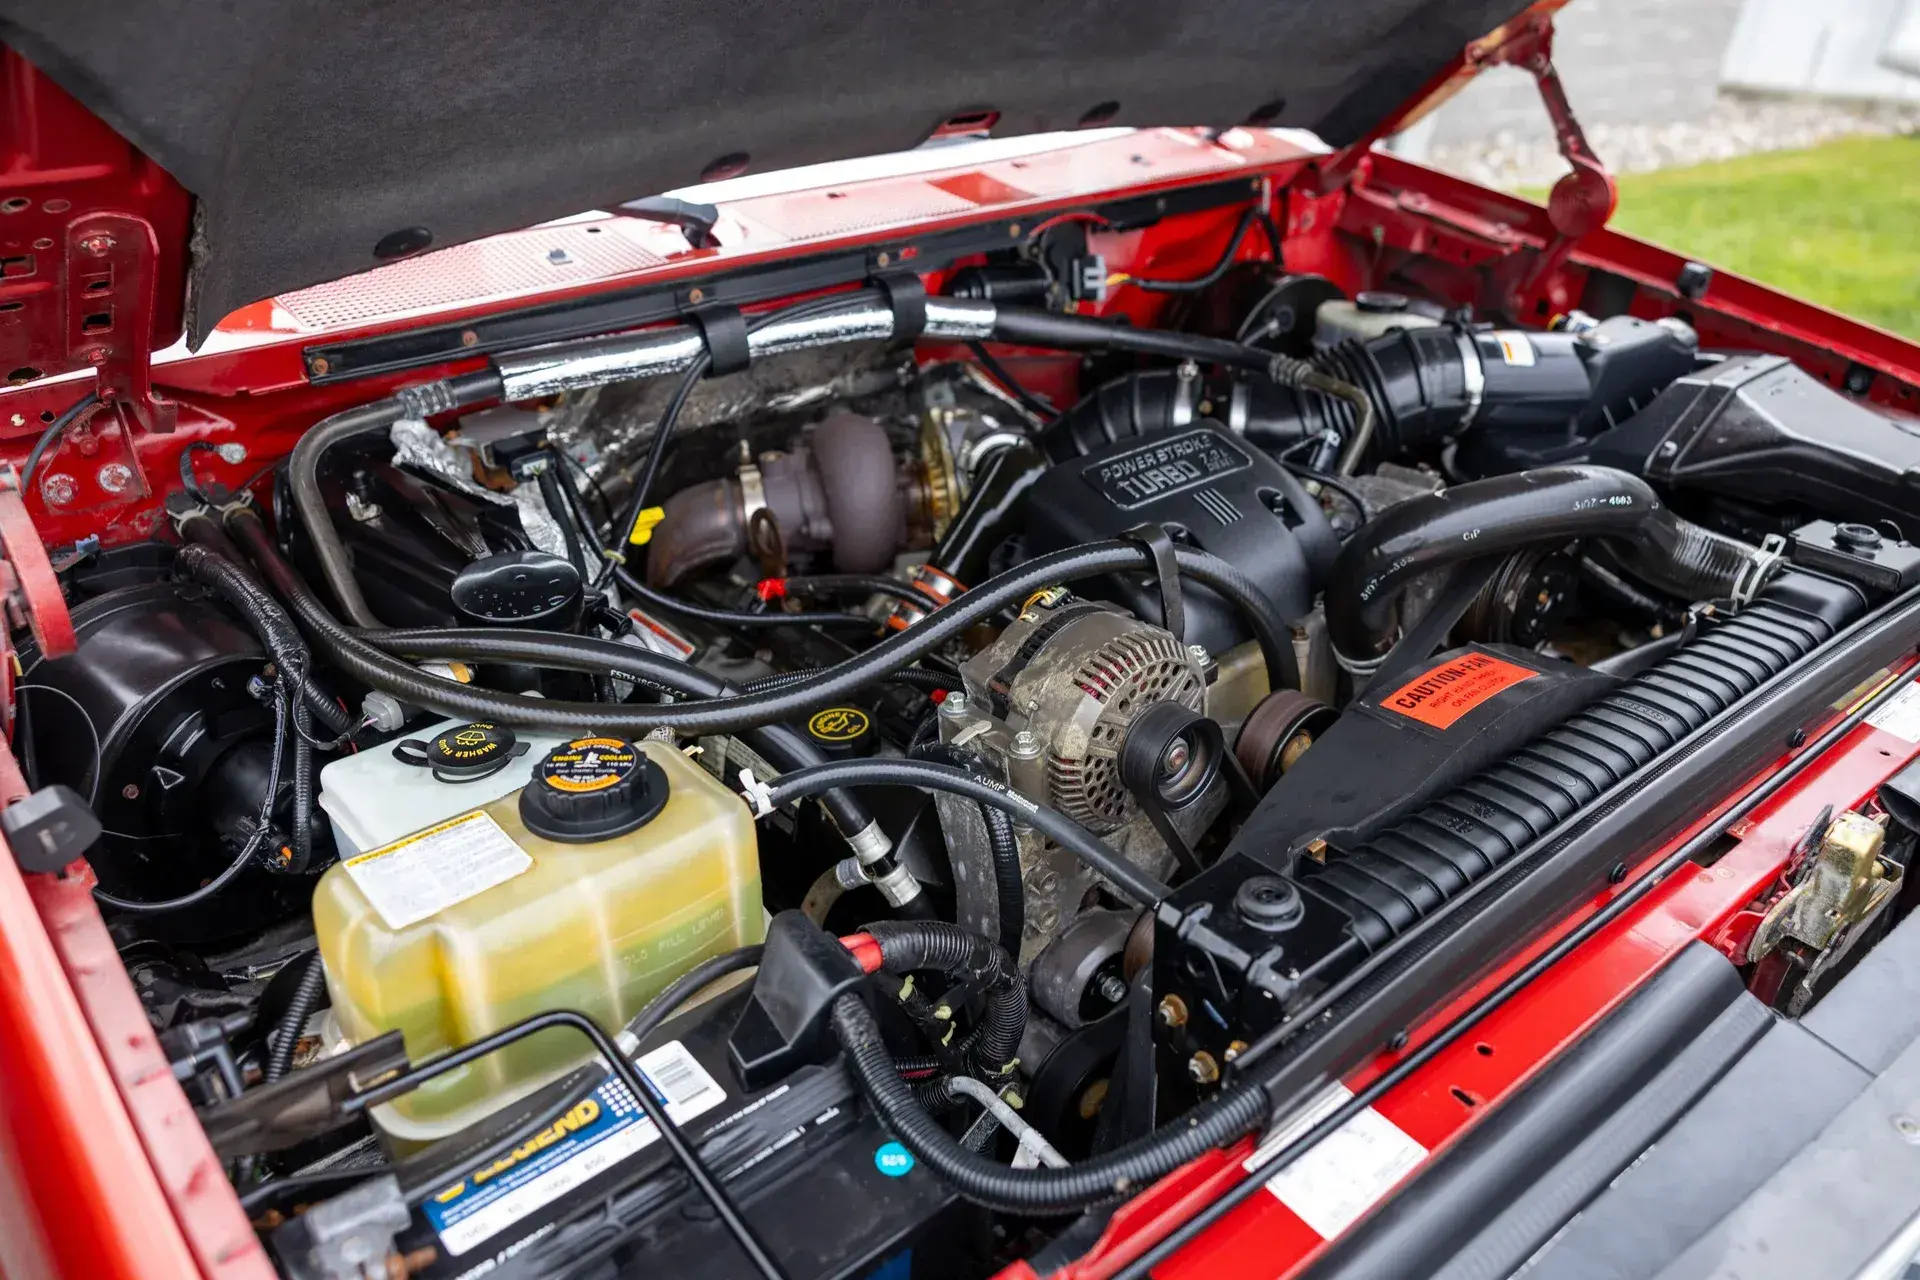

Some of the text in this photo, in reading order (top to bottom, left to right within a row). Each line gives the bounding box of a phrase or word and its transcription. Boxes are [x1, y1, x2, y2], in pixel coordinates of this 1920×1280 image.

[1117, 458, 1202, 498] TURBO
[438, 739, 498, 758] WASHER FLUID
[1006, 789, 1039, 814] Motorcraft
[657, 933, 687, 951] FILL
